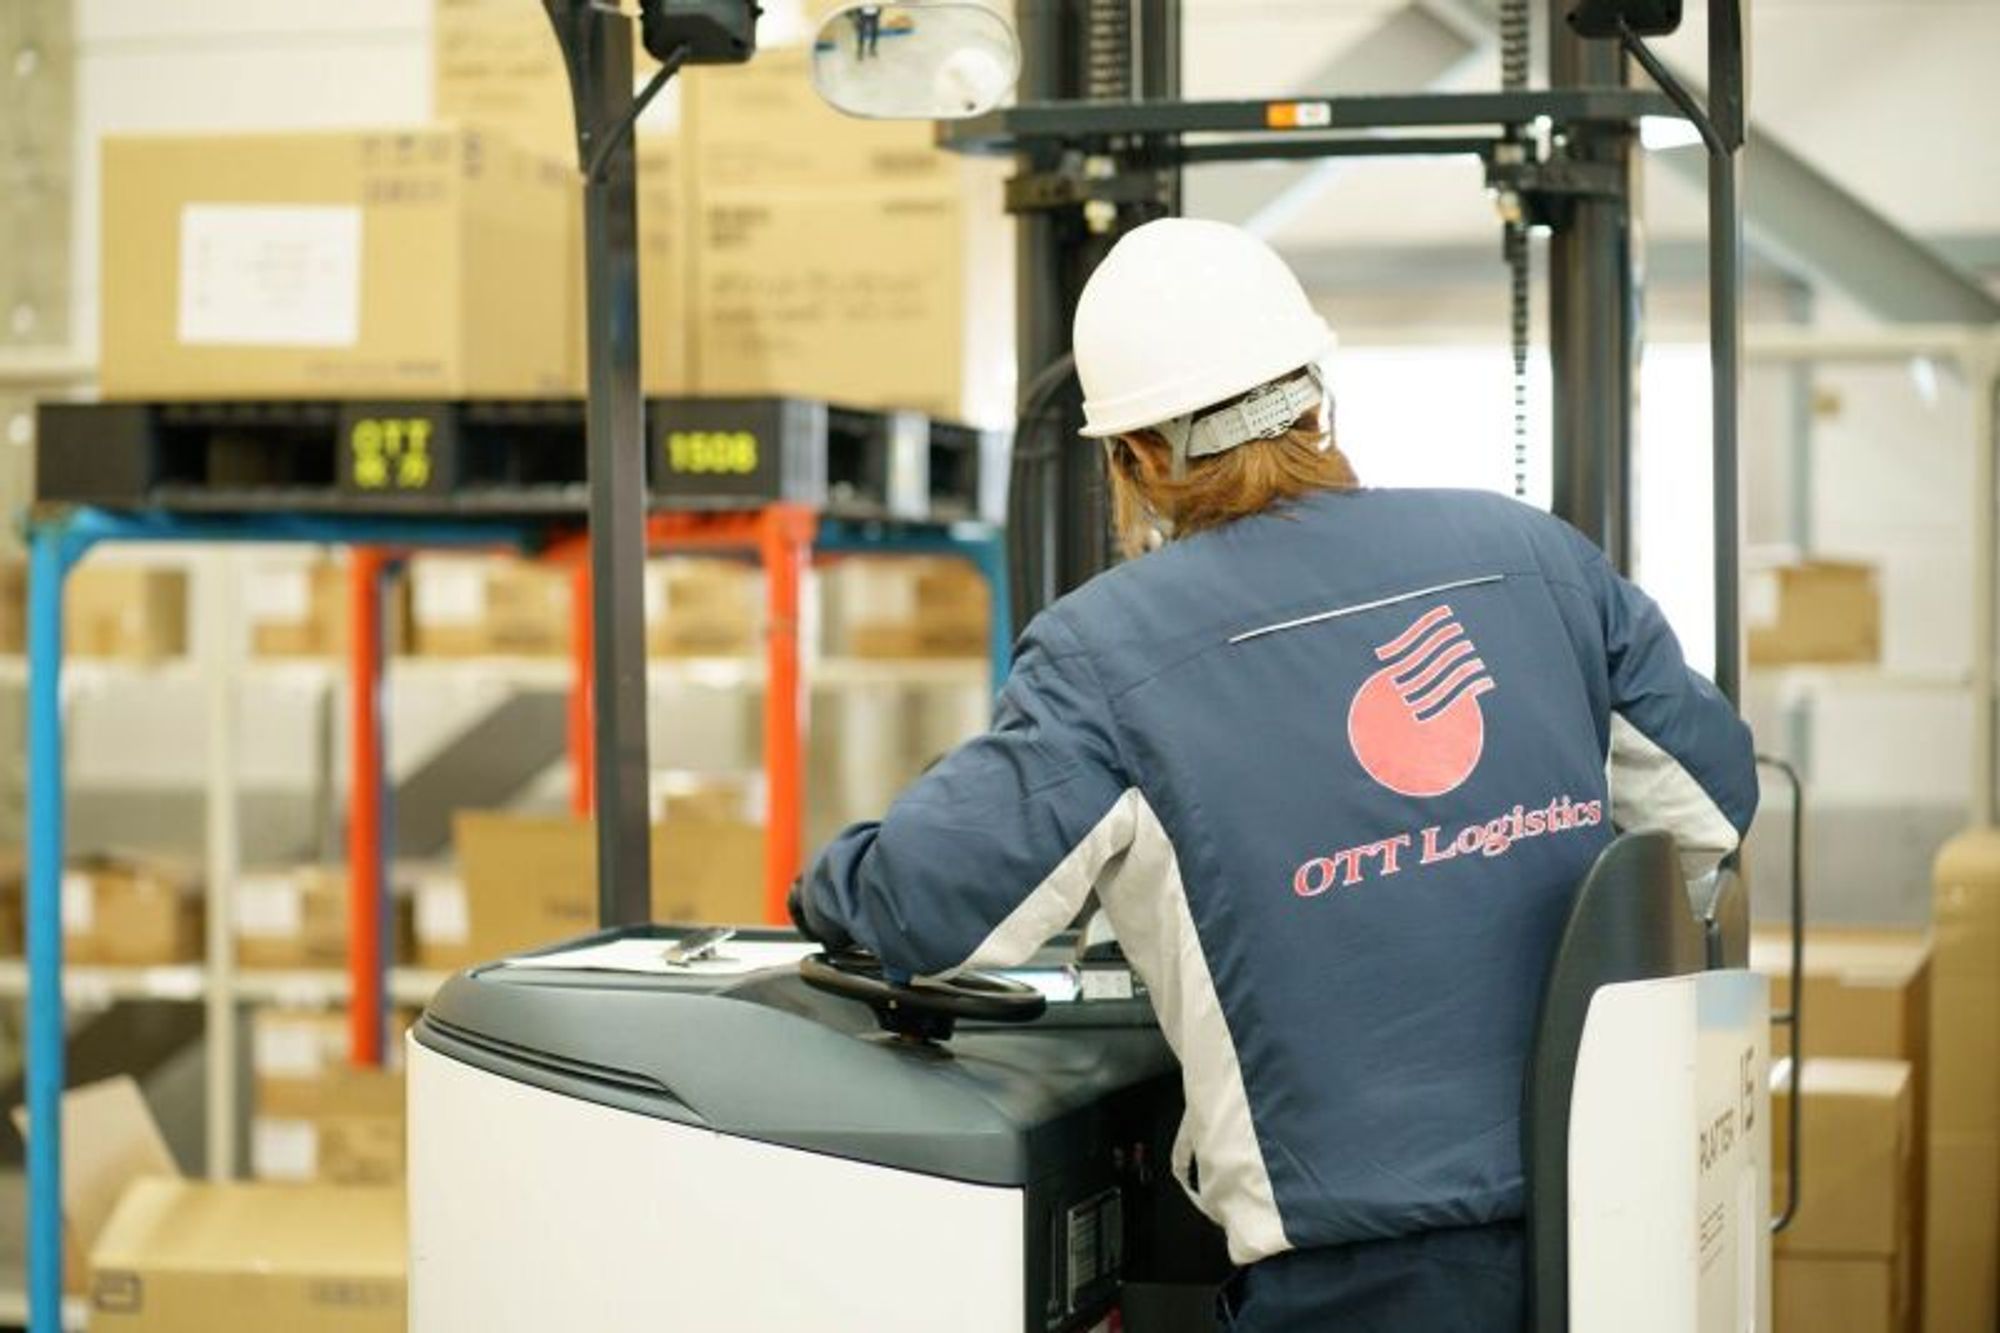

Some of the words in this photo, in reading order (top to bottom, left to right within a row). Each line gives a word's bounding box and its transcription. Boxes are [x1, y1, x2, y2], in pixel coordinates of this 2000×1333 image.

[352, 418, 431, 455] OTT
[1294, 834, 1411, 897] OTT
[1420, 795, 1602, 864] Logistics
